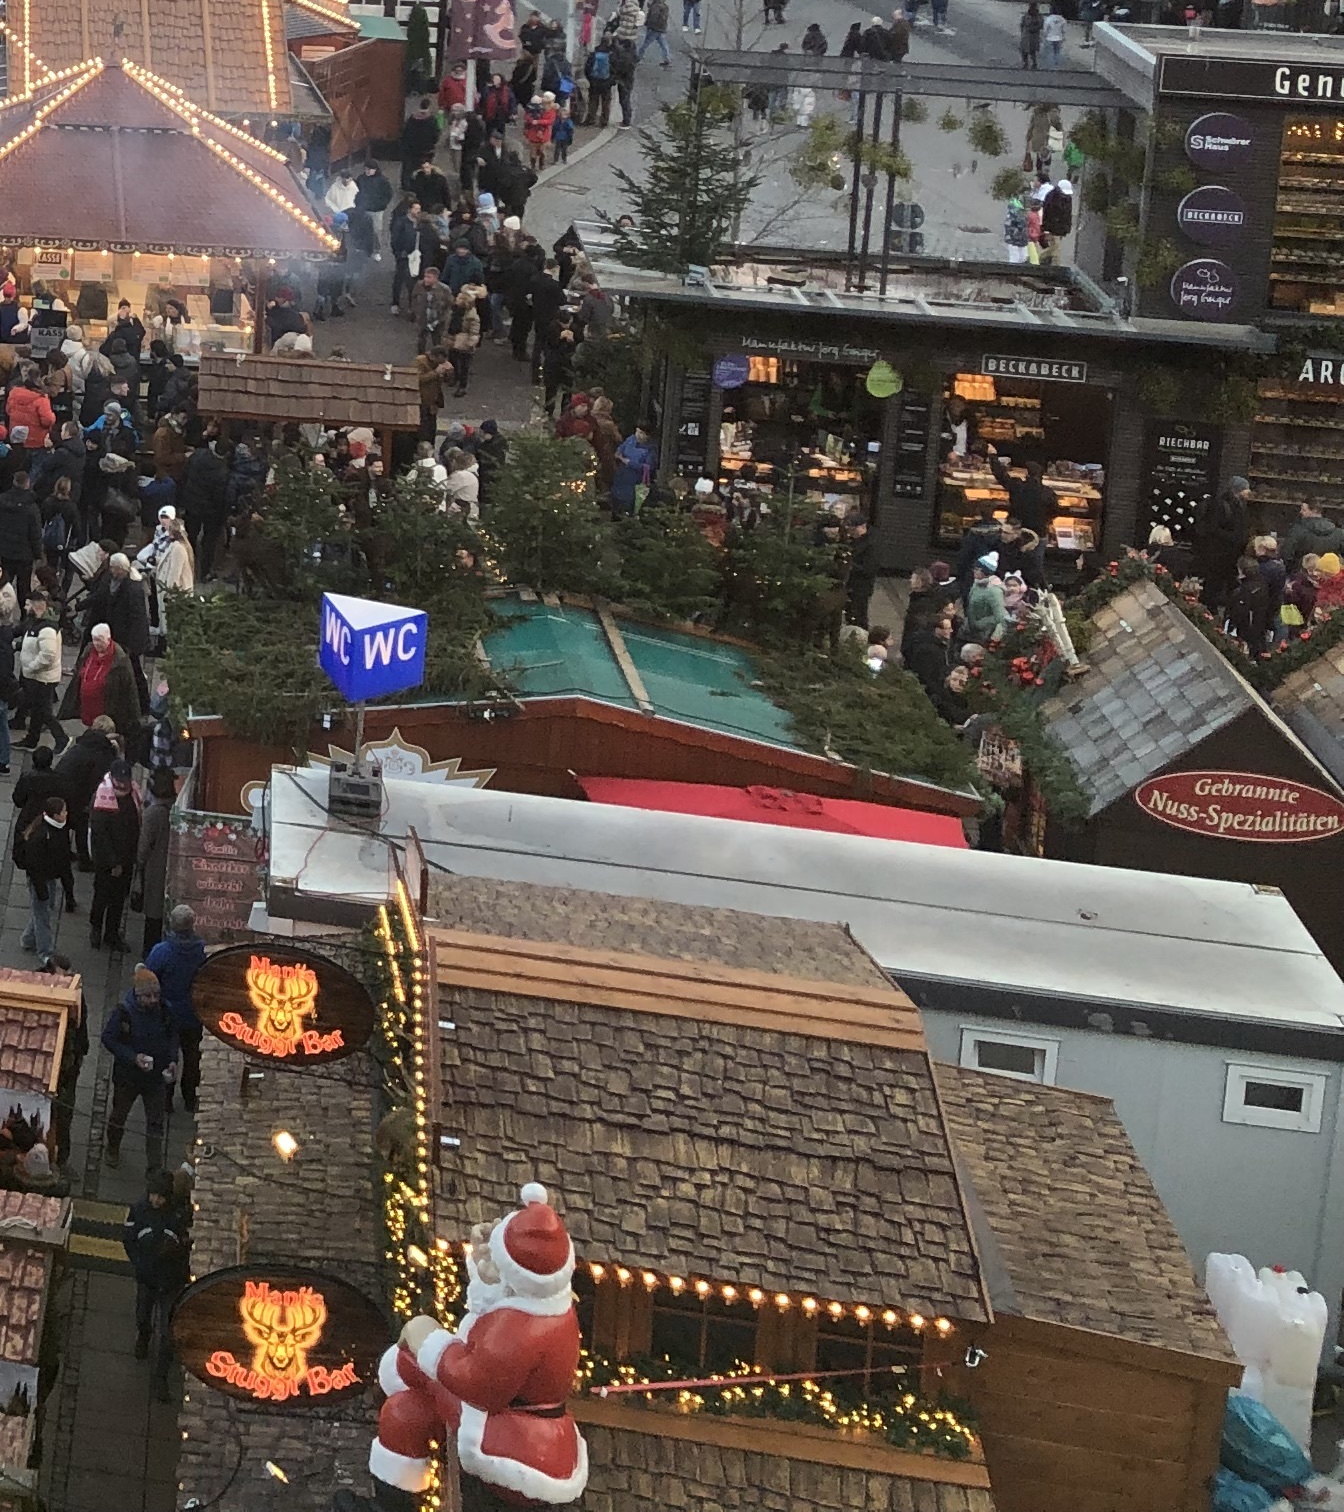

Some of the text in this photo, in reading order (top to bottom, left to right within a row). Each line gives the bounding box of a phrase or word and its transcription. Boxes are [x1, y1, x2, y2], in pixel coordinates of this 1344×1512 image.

[1204, 143, 1230, 152] Haus
[1158, 436, 1210, 450] RIECHBAR
[326, 604, 351, 666] WC
[363, 622, 418, 669] WC
[1194, 778, 1300, 804] Gebrannte
[1147, 789, 1340, 833] Nuss-Spezialitäten
[301, 1029, 346, 1055] Bar
[305, 1362, 359, 1396] Bar
